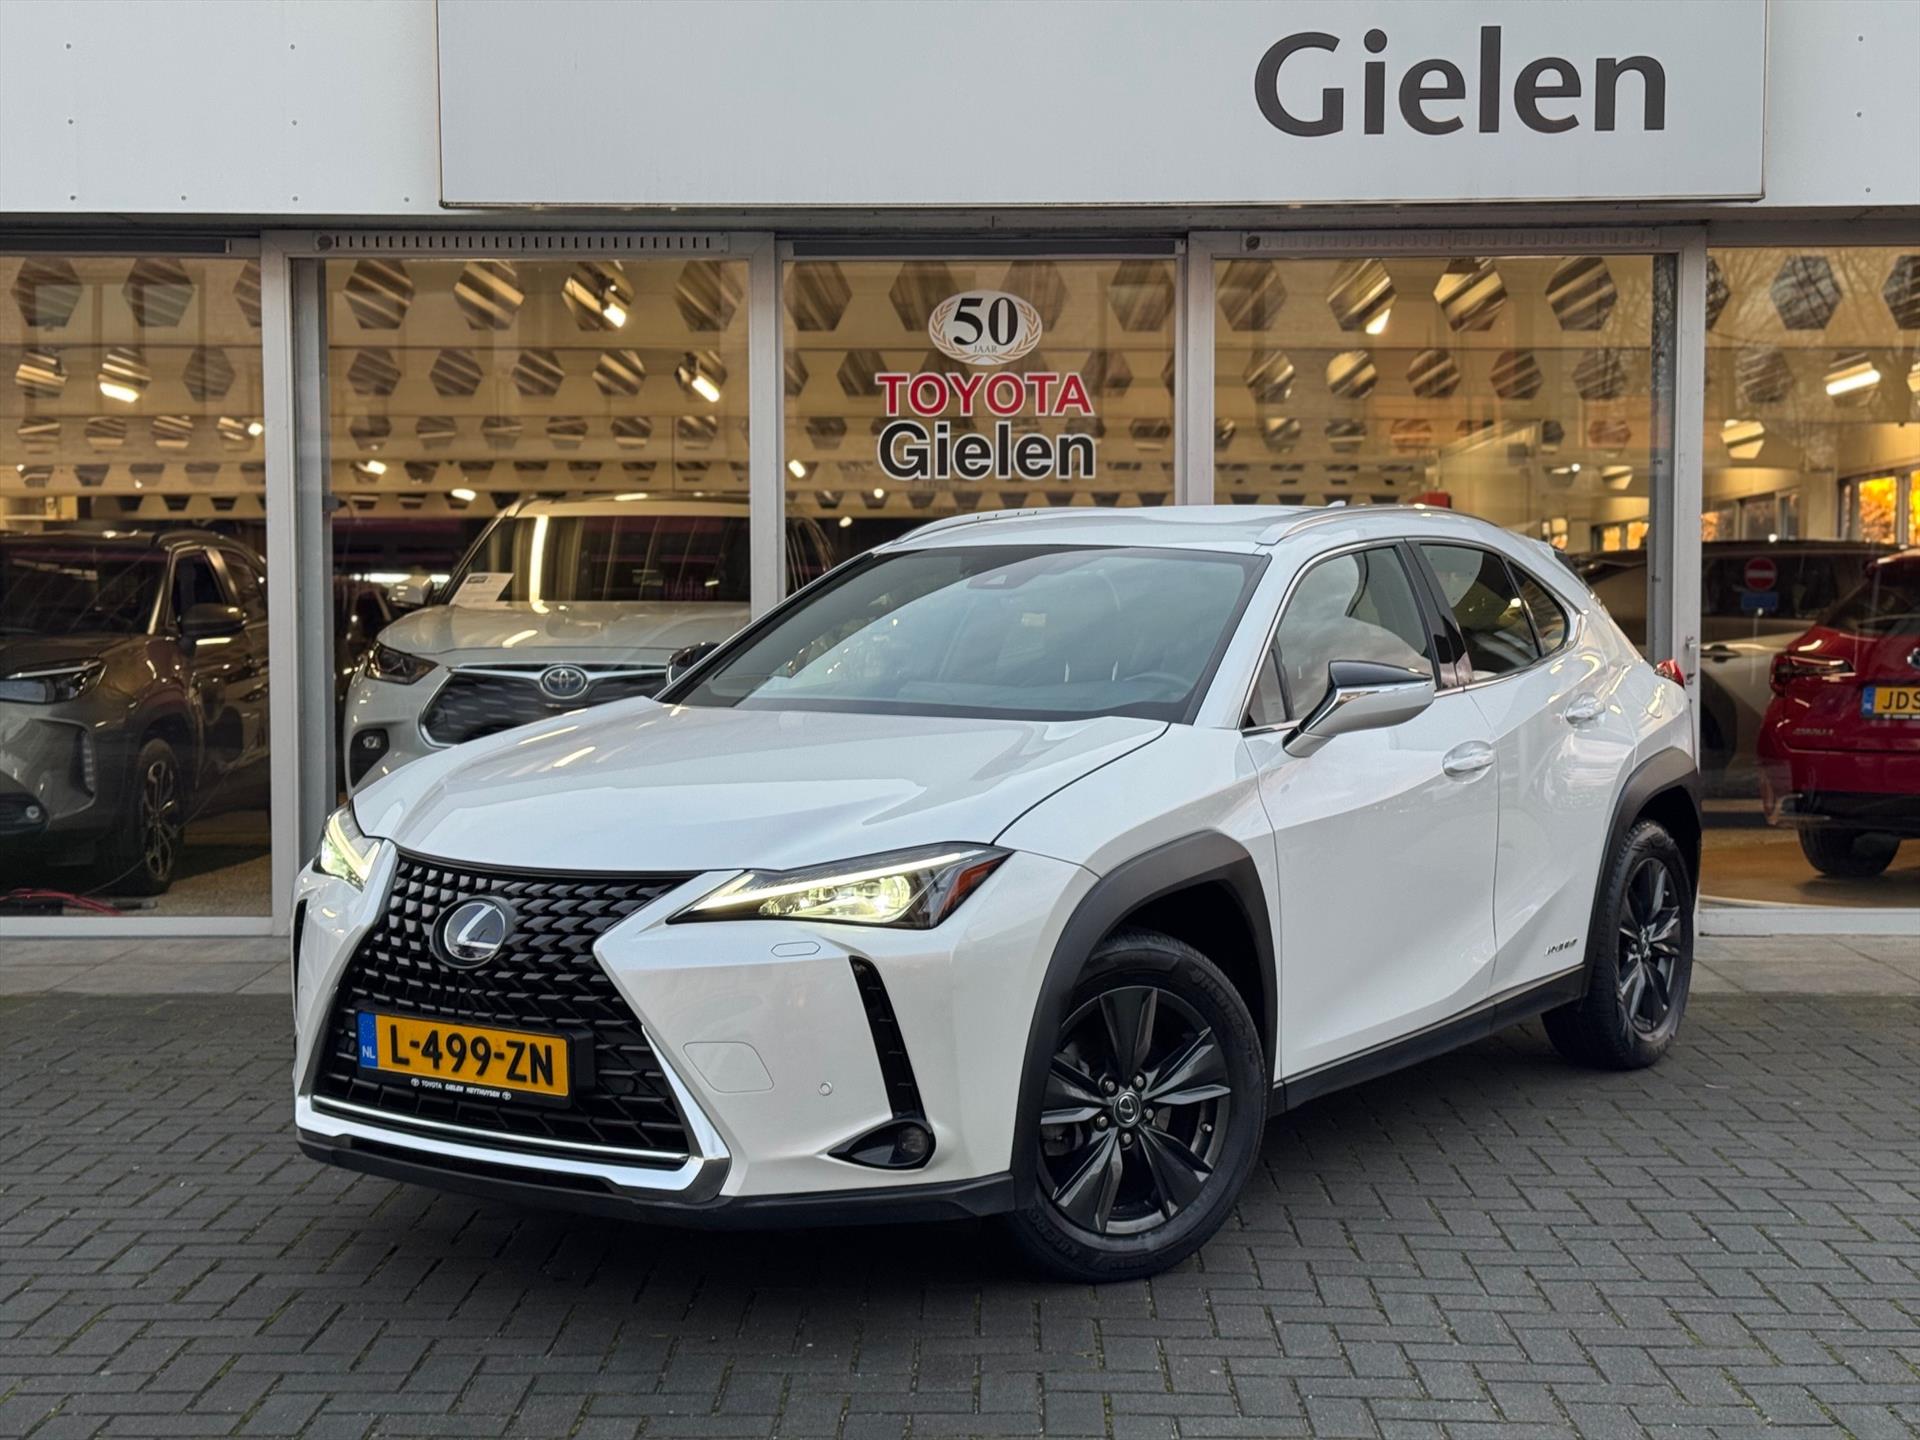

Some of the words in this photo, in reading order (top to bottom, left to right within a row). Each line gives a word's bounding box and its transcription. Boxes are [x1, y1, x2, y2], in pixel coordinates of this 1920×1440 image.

[1254, 26, 1666, 137] Gielen
[953, 297, 1018, 345] 50
[973, 345, 998, 353] JAAR
[875, 372, 1095, 417] TOYOTA
[877, 420, 1096, 480] Gielen
[361, 1045, 376, 1059] NL
[390, 1024, 553, 1086] L-499-ZN
[421, 1079, 442, 1089] TOYOTA
